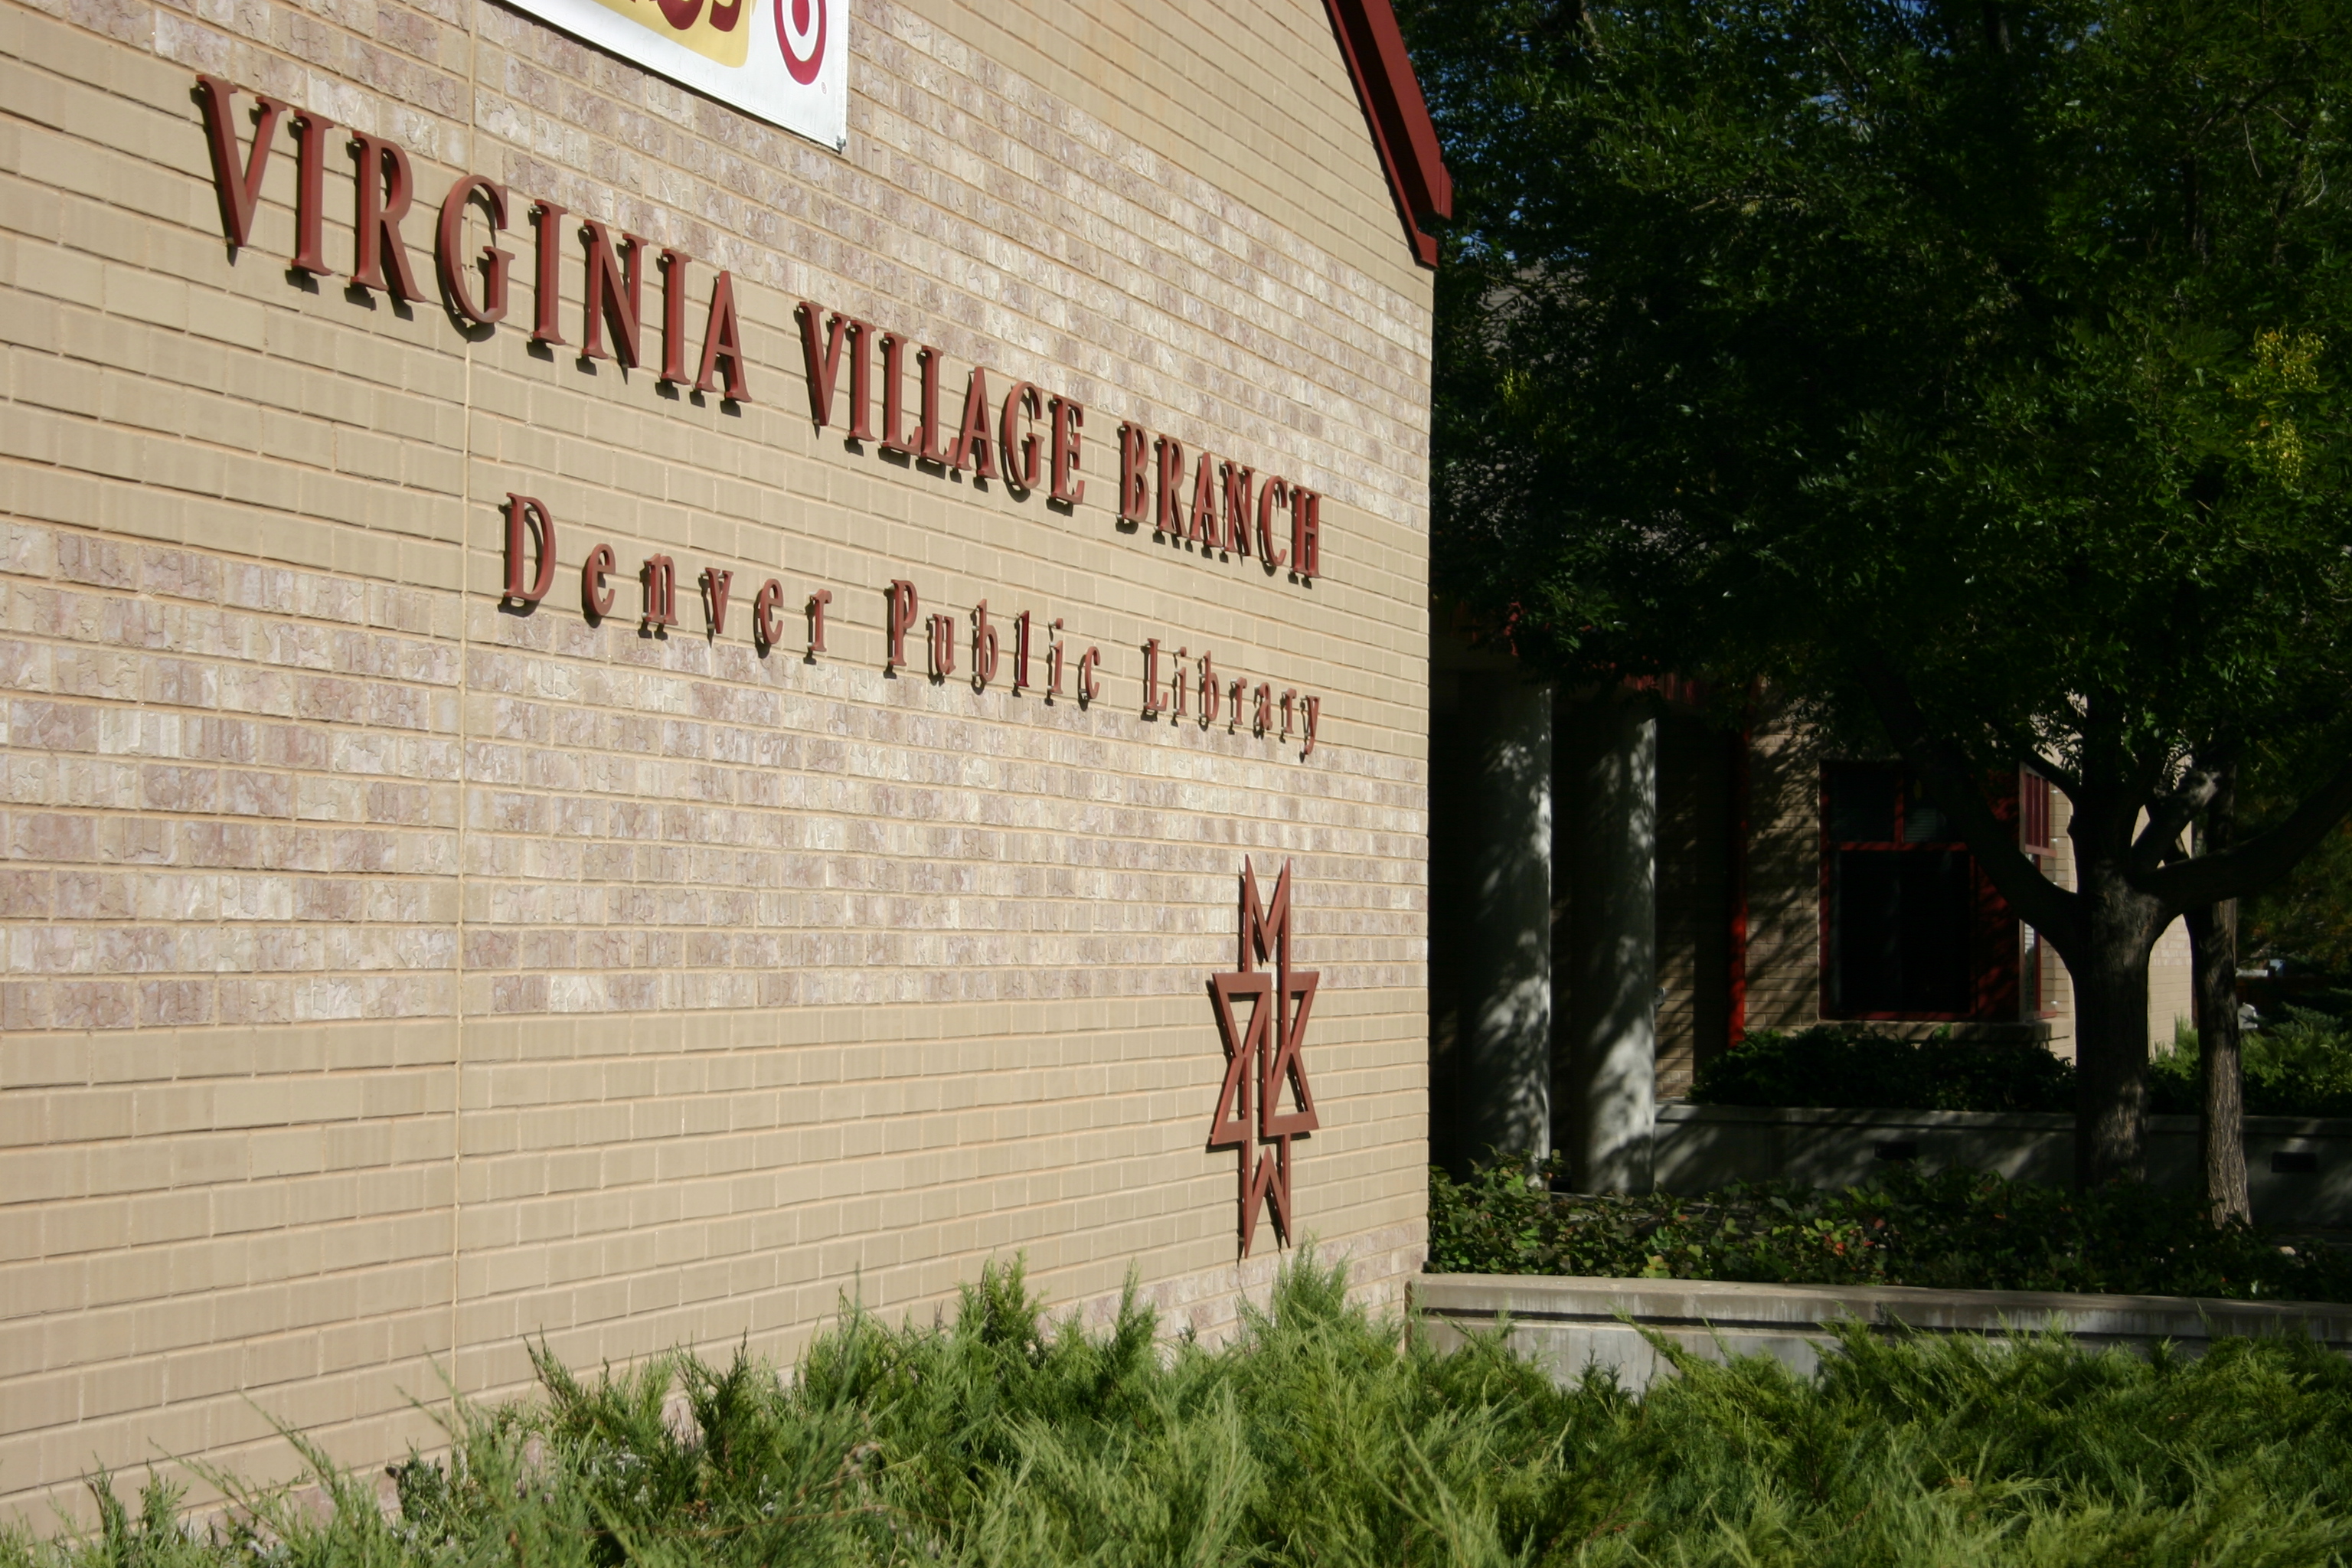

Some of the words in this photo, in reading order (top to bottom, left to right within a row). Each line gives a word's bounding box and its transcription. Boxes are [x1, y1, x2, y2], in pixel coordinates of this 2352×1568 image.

[197, 74, 752, 403] VIRGINIA
[799, 301, 1085, 505] VILLAGE
[1122, 420, 1322, 580] BRANCH
[503, 492, 832, 653] Denver
[889, 579, 1101, 701] Public
[1147, 637, 1321, 756] Library
